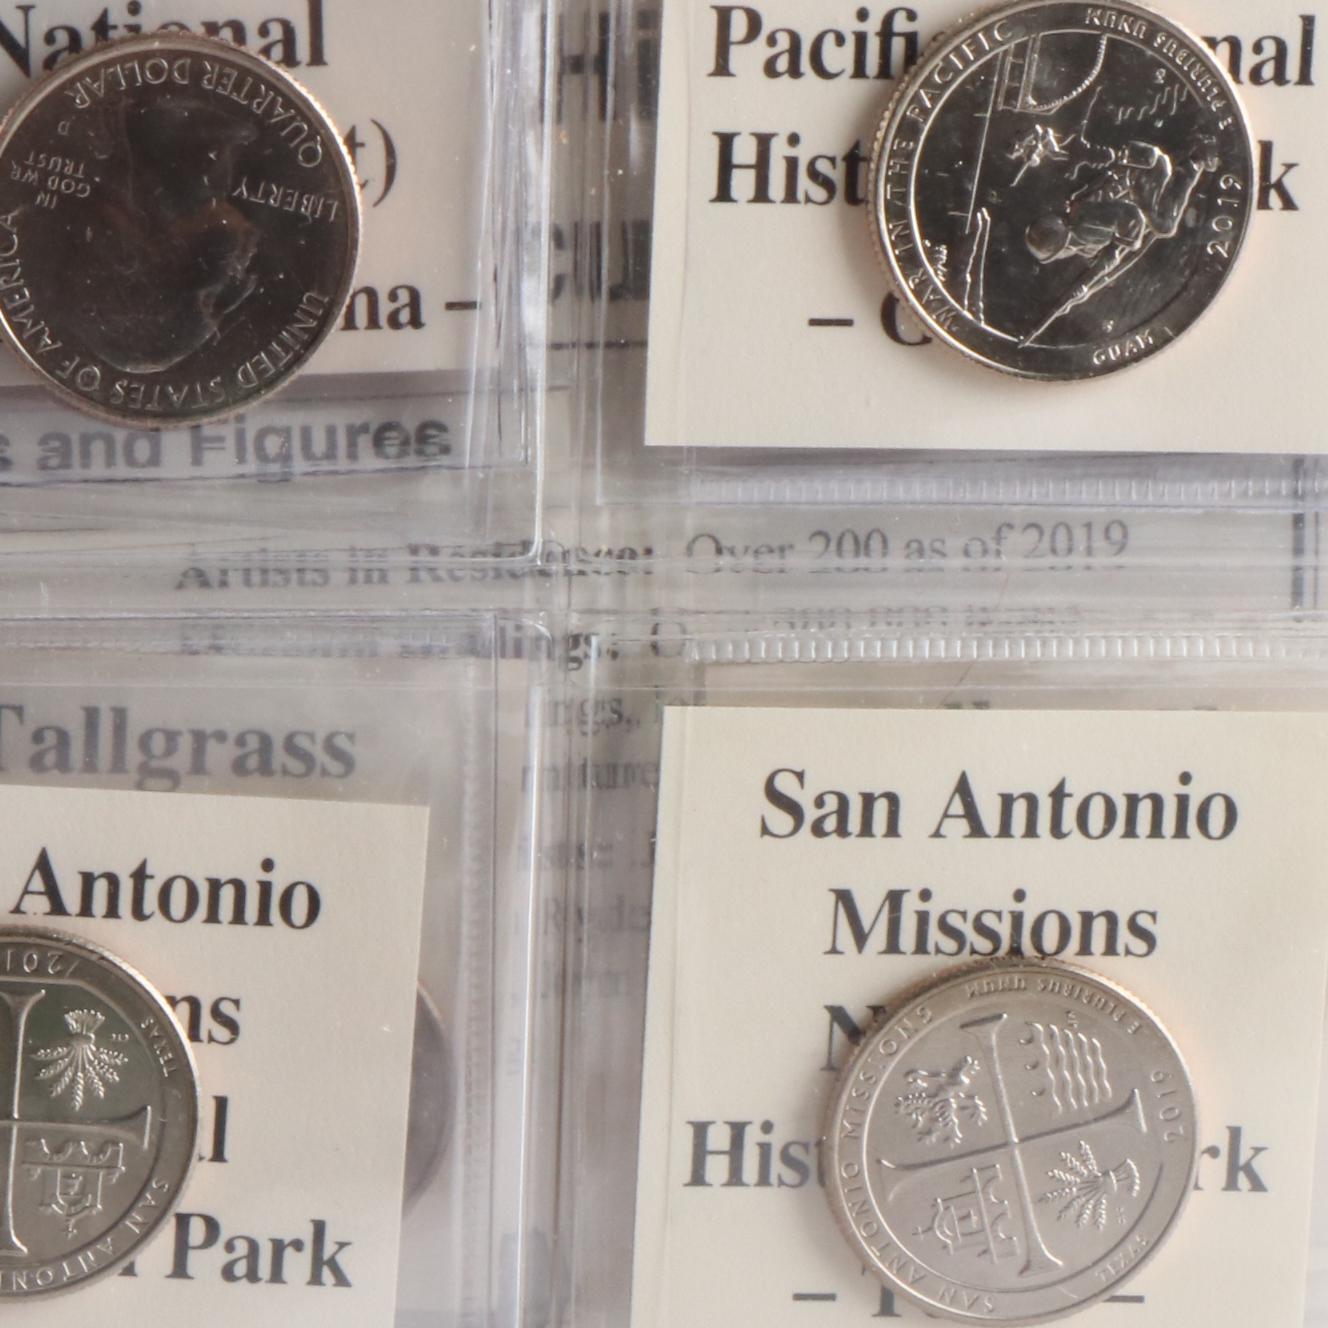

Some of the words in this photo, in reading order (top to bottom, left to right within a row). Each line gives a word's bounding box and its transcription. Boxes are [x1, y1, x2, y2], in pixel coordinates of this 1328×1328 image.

[706, 5, 922, 80] Pacifi
[1084, 7, 1146, 39] UNUM
[64, 56, 192, 110] DOLLAR
[905, 18, 1013, 123] PACIFIC
[1152, 31, 1227, 112] PLURIBUS
[203, 60, 323, 168] QUARTER
[24, 150, 85, 179] TRUST
[48, 177, 91, 198] GOD
[886, 140, 915, 200] THE
[231, 176, 339, 224] LIBERTY
[1206, 173, 1243, 258] 2019
[908, 272, 960, 331] WAR
[237, 291, 331, 387] UNITED
[1092, 331, 1155, 365] GUAM
[56, 355, 101, 392] OF
[109, 375, 226, 410] STATES
[37, 426, 162, 471] and
[188, 419, 451, 482] Figures
[758, 767, 902, 841] San
[928, 769, 1238, 843] Antonio
[8, 846, 322, 931] Antonio
[822, 887, 1159, 958] Missions
[840, 1004, 934, 1139] MISSIONS
[1150, 1069, 1185, 1143] 2019
[125, 1177, 169, 1235] SAN
[840, 1161, 928, 1284] ANTONIO
[164, 1212, 354, 1289] Park
[937, 1285, 995, 1313] SAN
